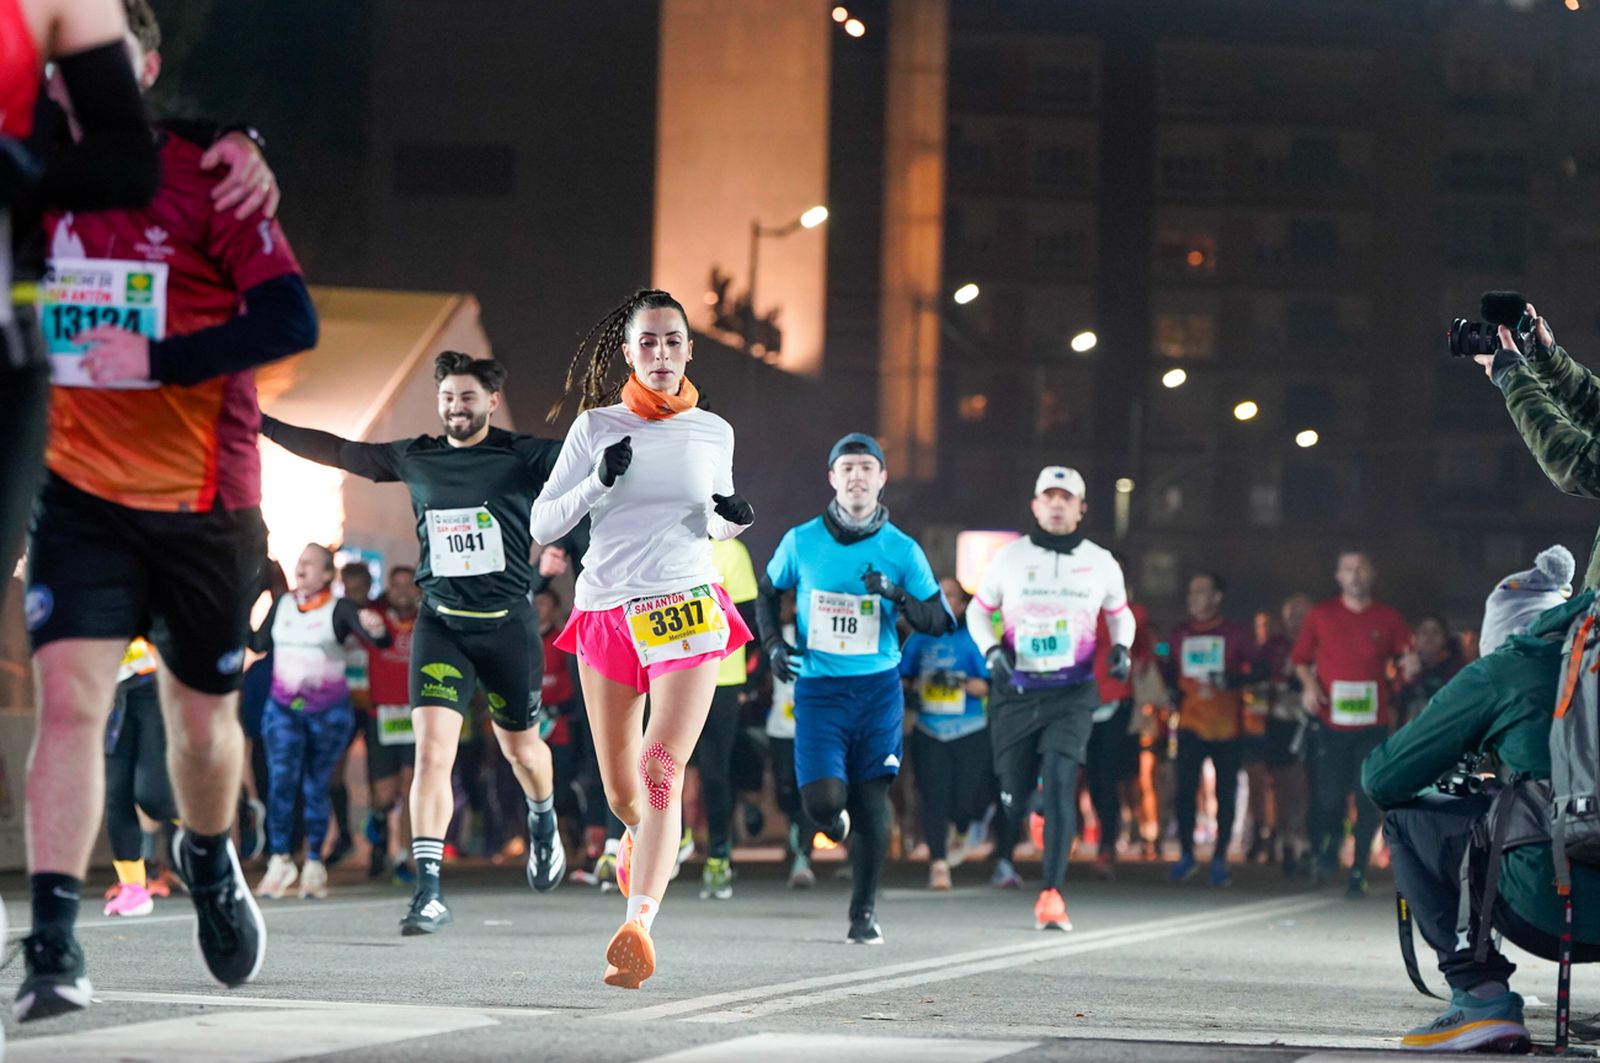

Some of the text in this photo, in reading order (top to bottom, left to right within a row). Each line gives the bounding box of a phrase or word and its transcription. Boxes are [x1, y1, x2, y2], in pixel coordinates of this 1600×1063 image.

[446, 532, 485, 553] 1041
[634, 601, 653, 615] SAN
[649, 600, 704, 637] 3317
[831, 616, 858, 634] 118
[669, 629, 696, 641] Mercedes
